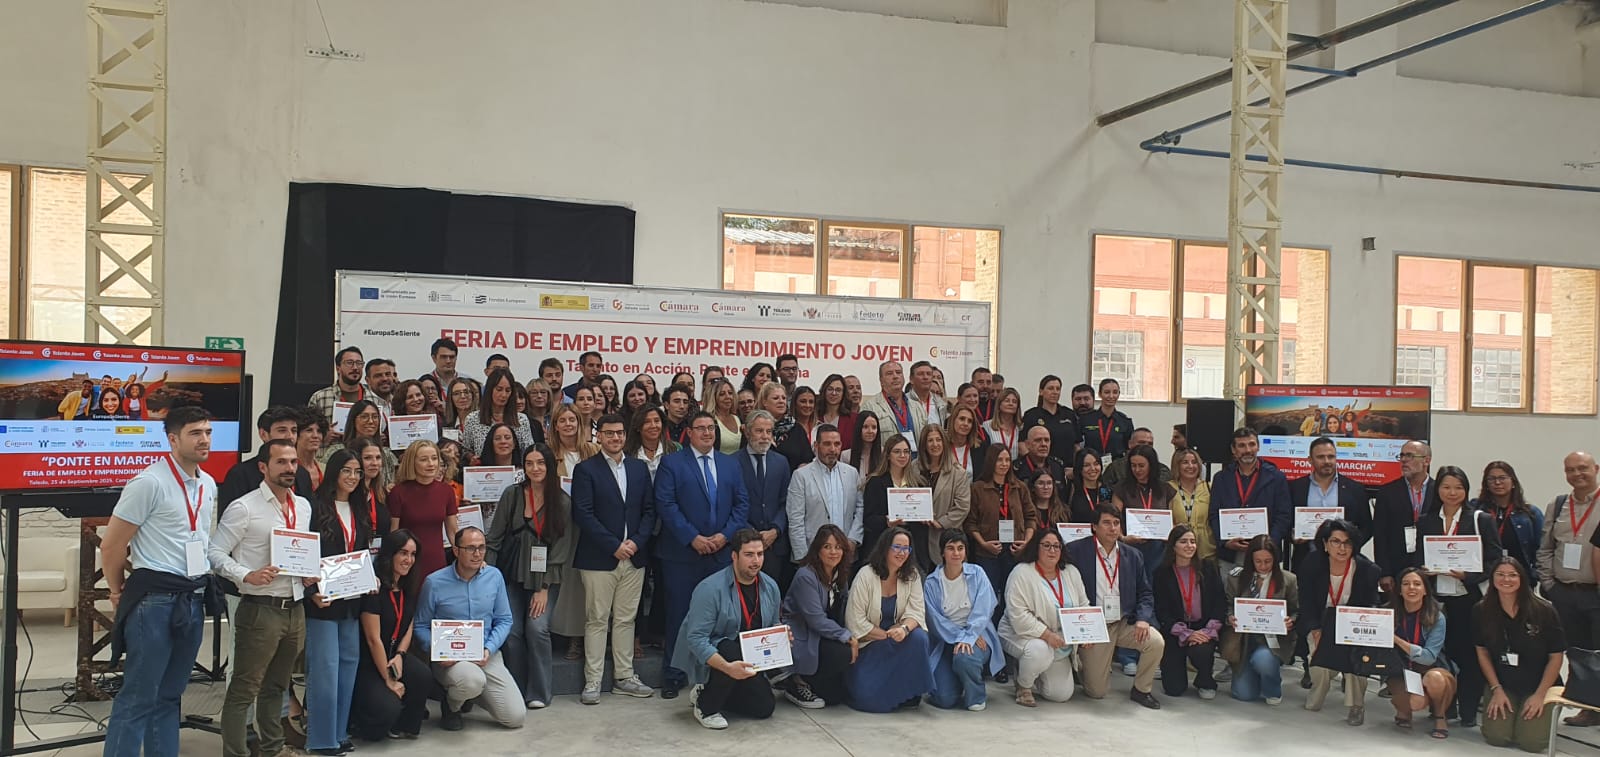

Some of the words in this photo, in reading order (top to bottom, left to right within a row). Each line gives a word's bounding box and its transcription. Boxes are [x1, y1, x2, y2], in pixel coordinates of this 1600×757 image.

[659, 300, 699, 312] Cámara
[711, 302, 746, 313] Cámara
[363, 329, 421, 337] #EuropaSeSiente
[440, 329, 507, 349] FERIA
[514, 332, 543, 350] DE
[549, 333, 638, 353] EMPLEO
[644, 337, 658, 354] Y
[664, 337, 846, 360] EMPRENDIMIENTO
[851, 344, 913, 362] JOVEN
[566, 360, 619, 373] Tanto
[623, 363, 640, 374] en
[644, 361, 695, 376] Acción.
[94, 456, 111, 466] EN
[1291, 460, 1312, 468] “PON
